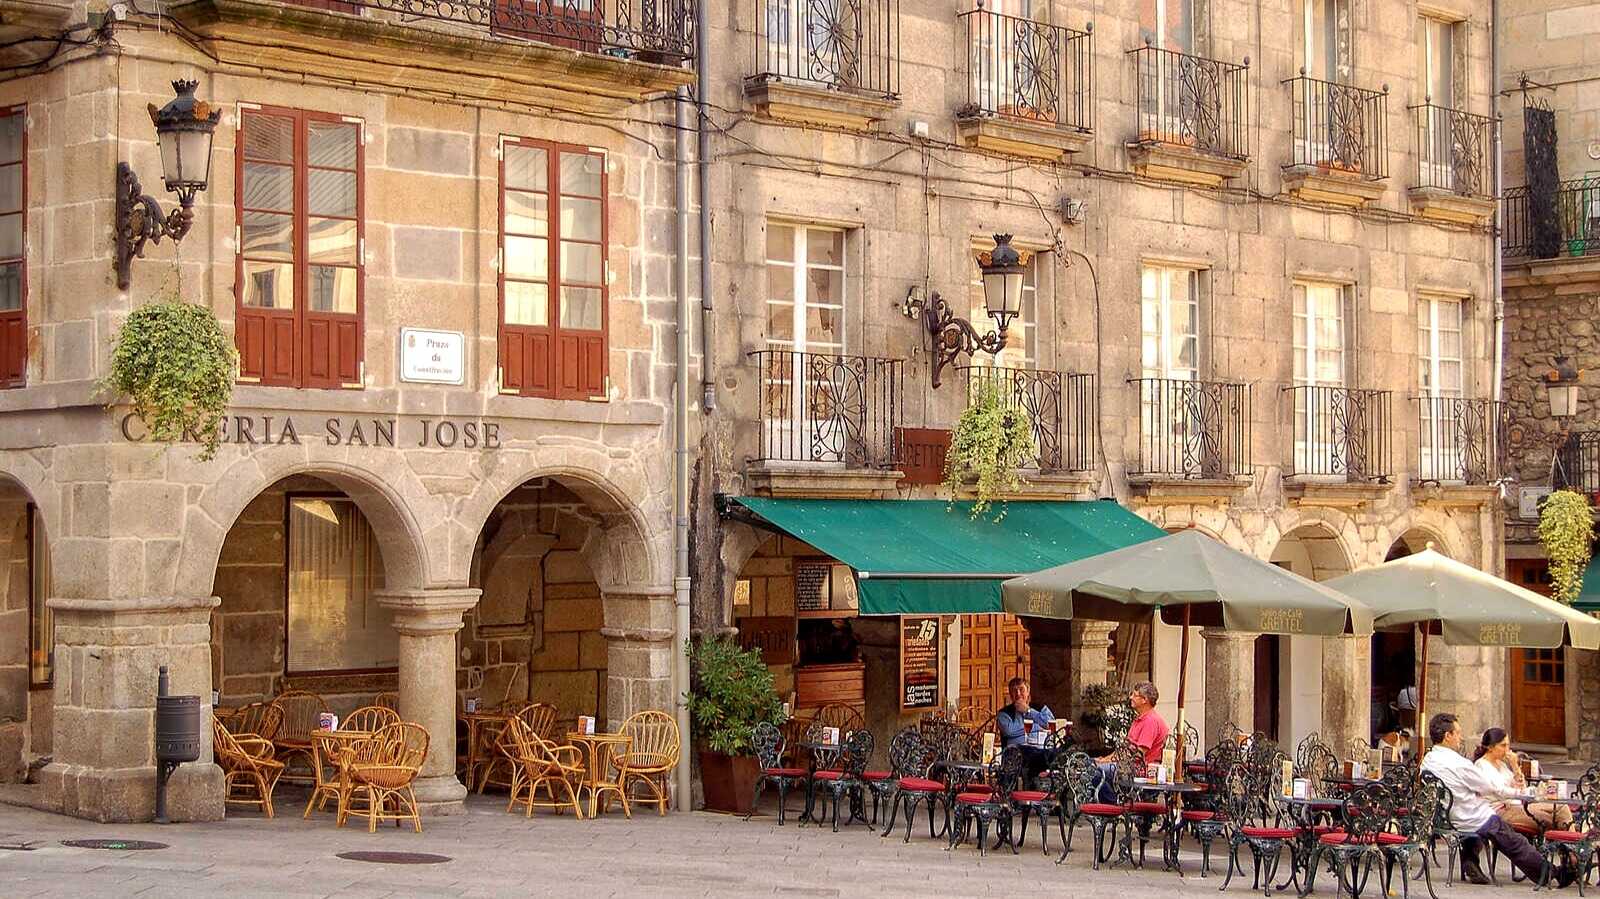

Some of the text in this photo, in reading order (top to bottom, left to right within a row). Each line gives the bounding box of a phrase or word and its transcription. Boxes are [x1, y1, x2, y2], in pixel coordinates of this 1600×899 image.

[121, 411, 502, 449] CRERIA SAN JOSE
[919, 619, 937, 641] 15
